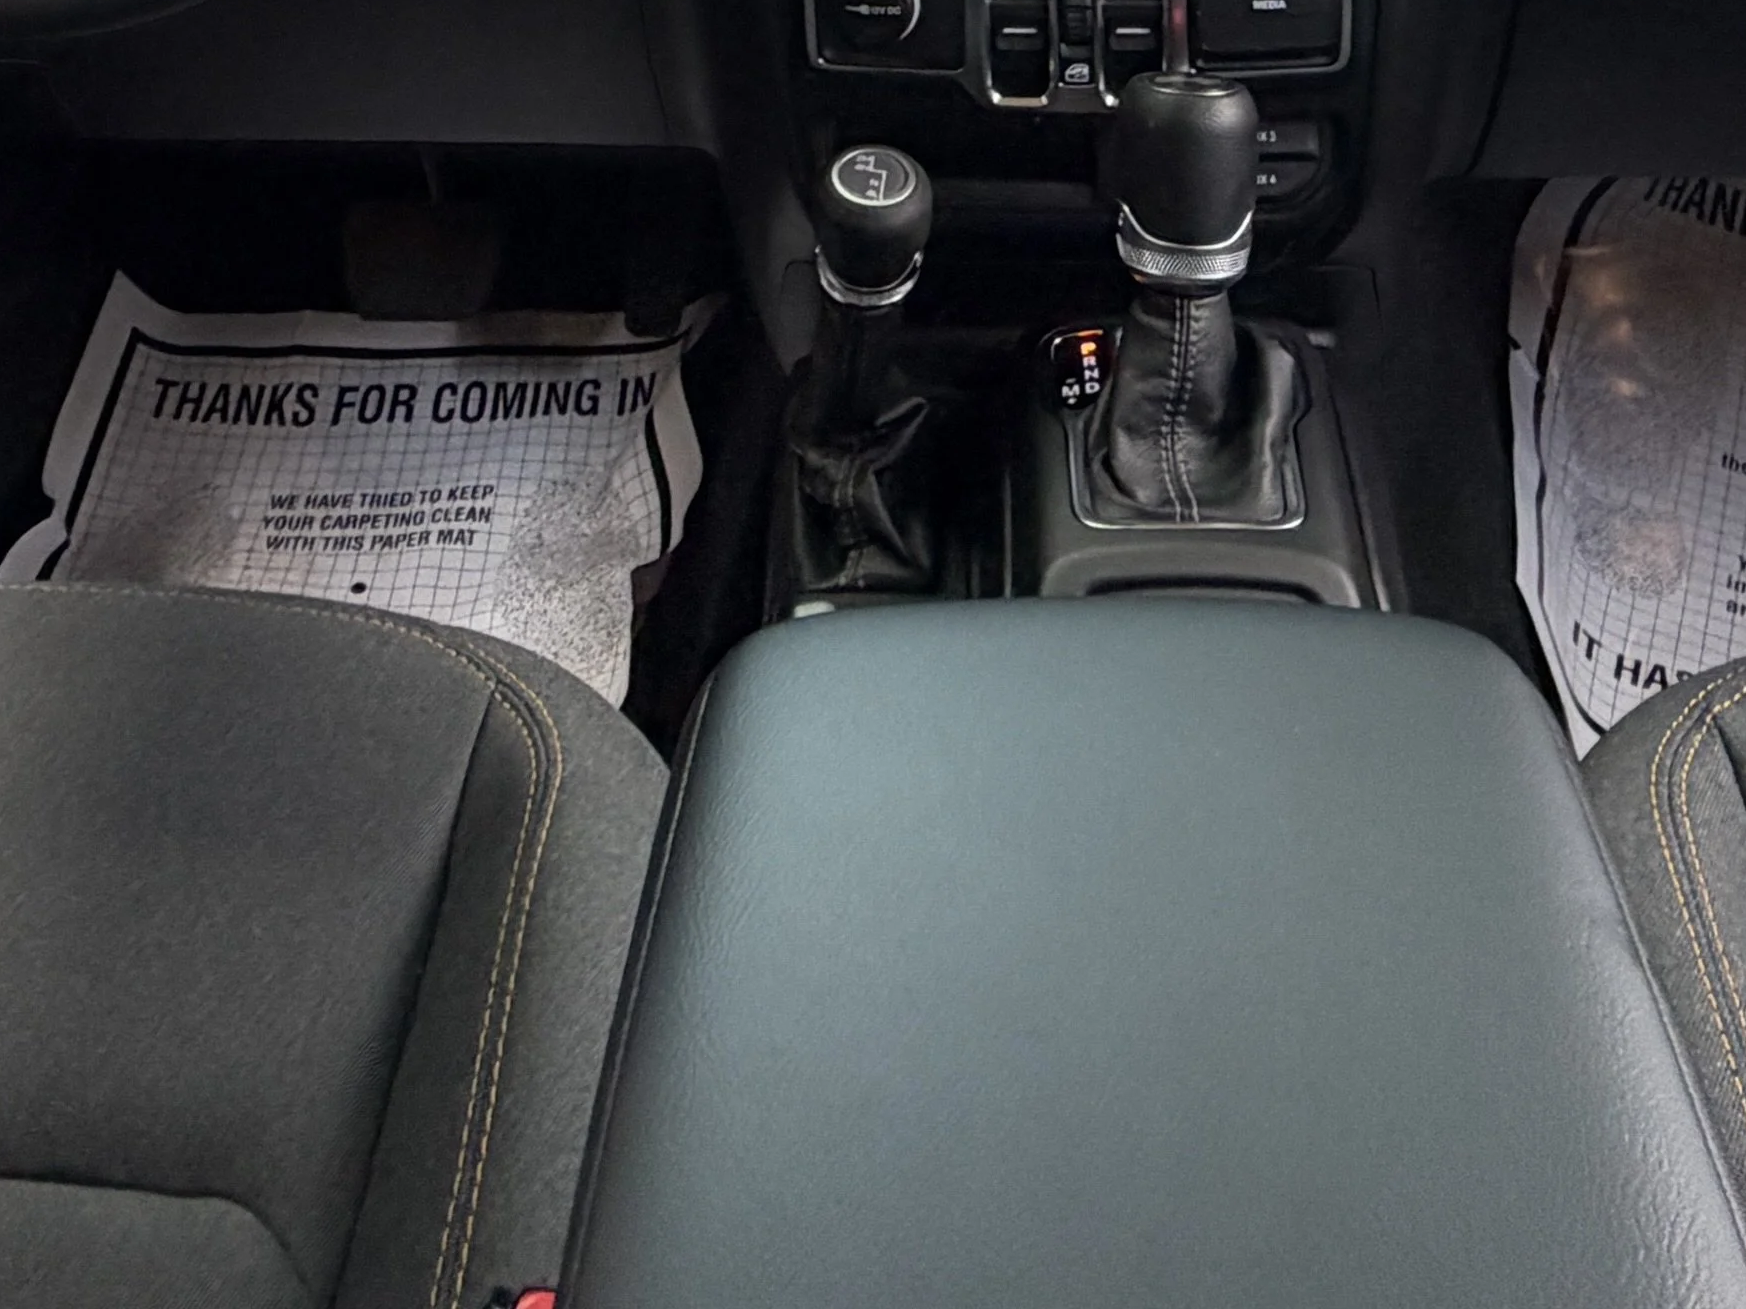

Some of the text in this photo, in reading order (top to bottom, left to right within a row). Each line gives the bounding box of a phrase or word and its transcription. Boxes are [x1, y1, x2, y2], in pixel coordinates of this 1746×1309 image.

[1252, 0, 1286, 11] MEDIA
[1080, 341, 1097, 355] P
[1082, 355, 1097, 368] R
[1083, 367, 1099, 380] N
[1061, 384, 1080, 398] M
[1084, 381, 1100, 394] D
[152, 370, 656, 427] THANKS FOR COMING IN
[270, 484, 494, 510] WE HAVE TRIED TO KEEP
[262, 506, 492, 531] YOUR CARPETING CLEAN
[265, 528, 481, 551] WITH THIS PAPER MAT
[1573, 620, 1602, 661] IT
